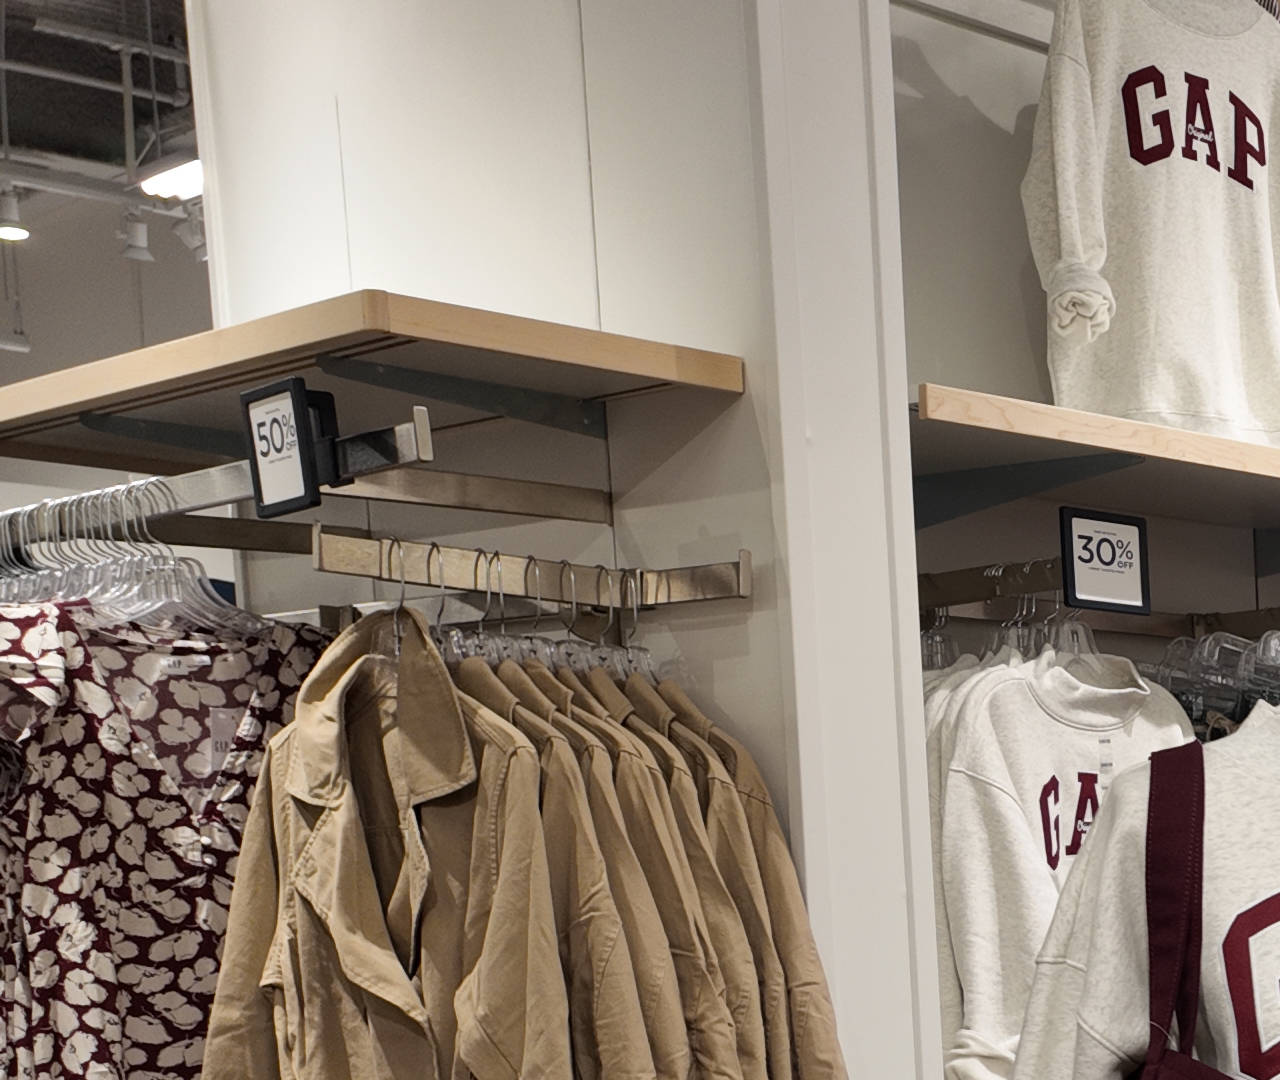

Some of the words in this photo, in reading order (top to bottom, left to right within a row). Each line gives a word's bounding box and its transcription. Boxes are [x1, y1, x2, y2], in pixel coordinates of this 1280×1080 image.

[1121, 65, 1267, 191] GAP
[256, 412, 296, 458] 50%
[1077, 534, 1134, 567] 30%
[1117, 560, 1134, 570] OFF
[1039, 771, 1100, 871] GA
